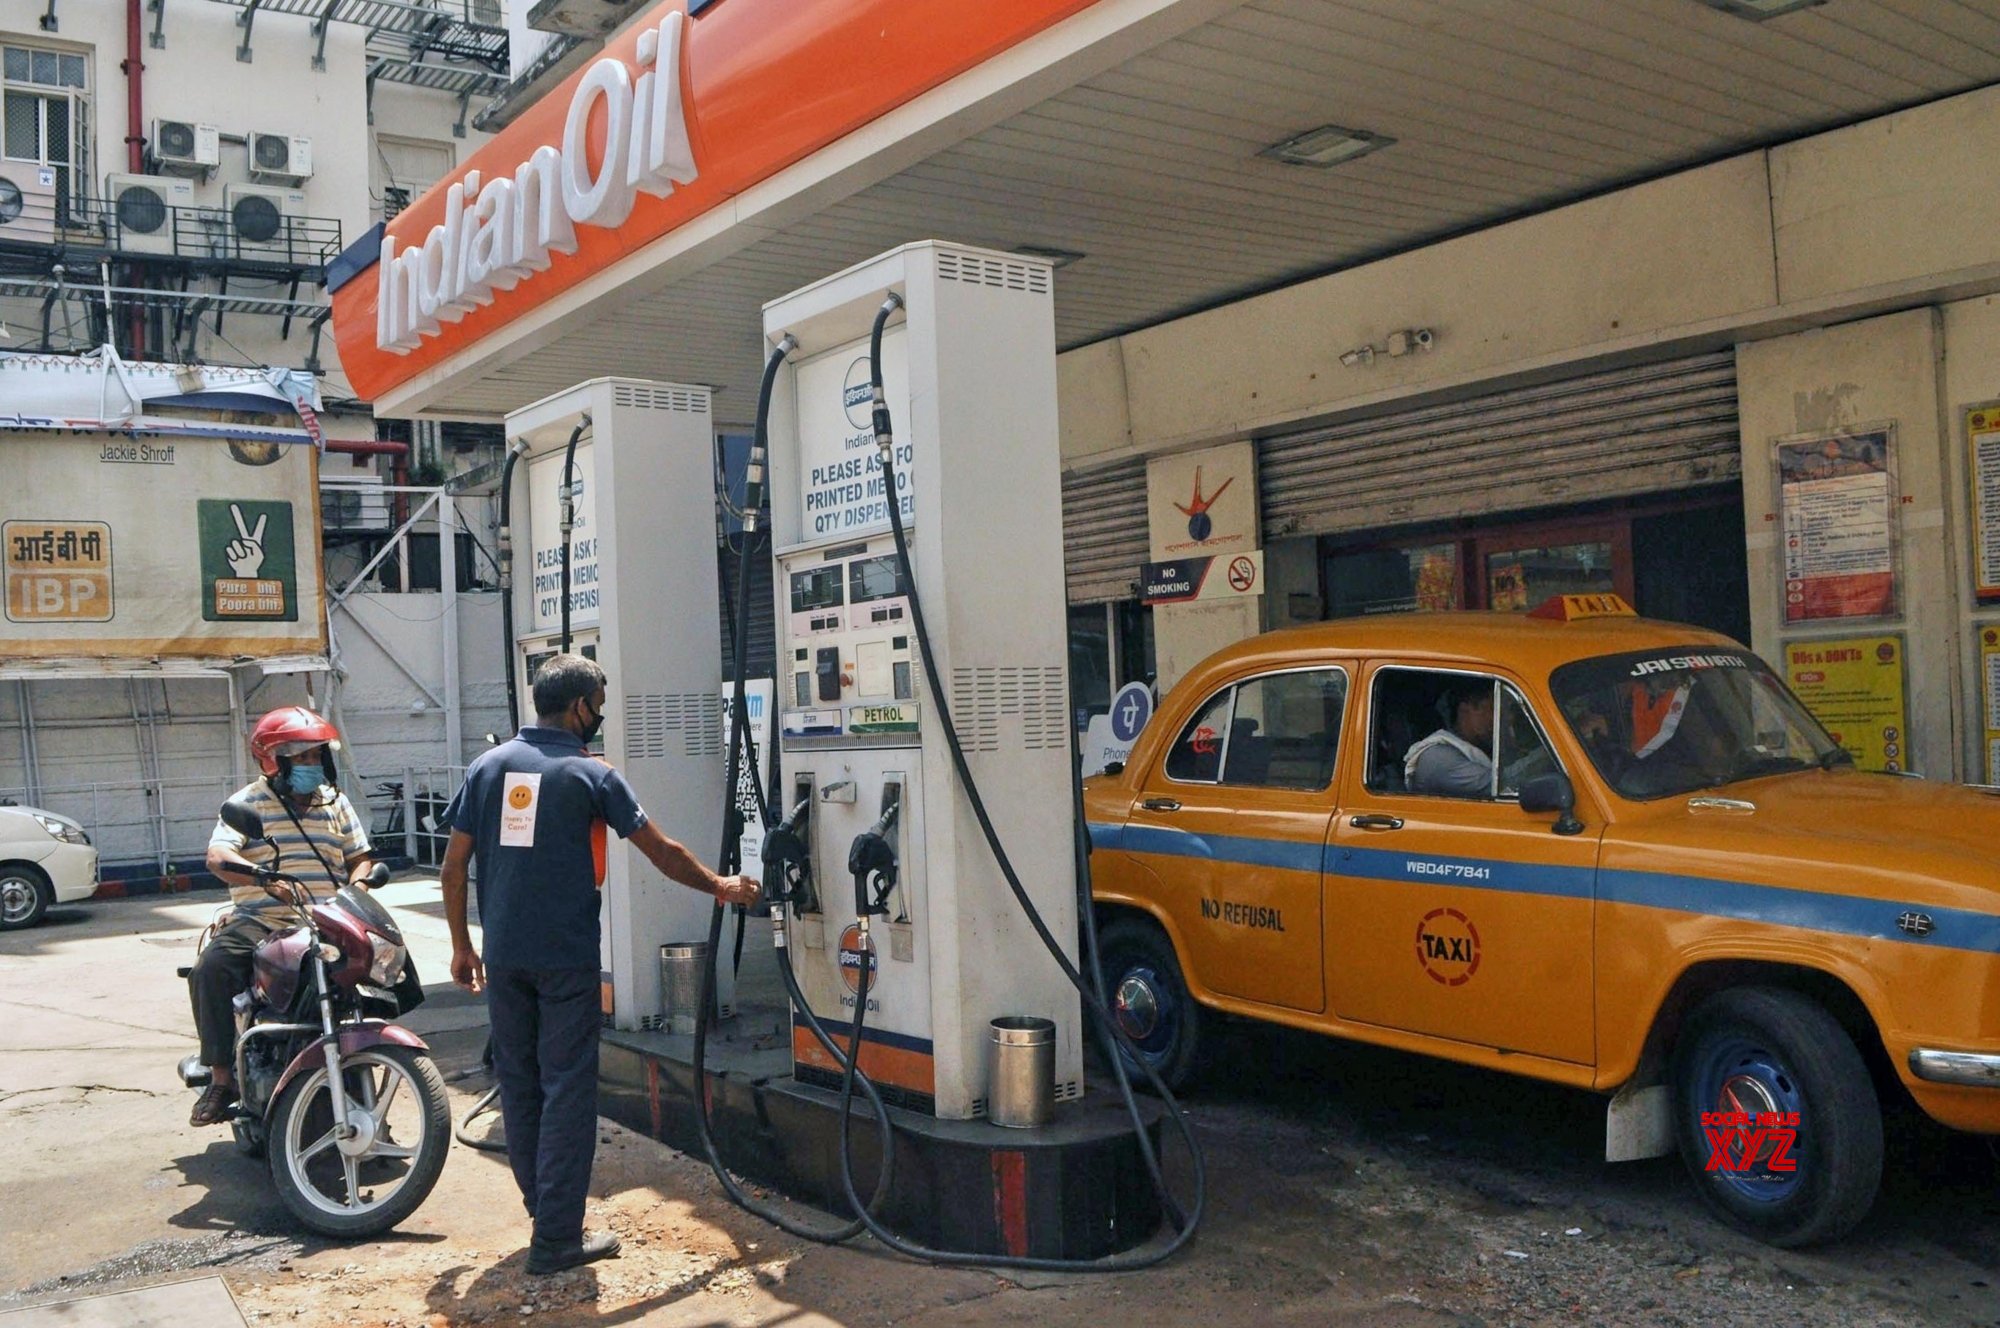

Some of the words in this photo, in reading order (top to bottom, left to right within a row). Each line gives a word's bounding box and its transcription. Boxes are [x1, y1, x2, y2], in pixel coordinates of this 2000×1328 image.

[377, 10, 698, 356] IndianOil
[845, 433, 875, 451] Indian
[100, 444, 137, 462] Jackie
[140, 445, 174, 463] Shroff
[812, 458, 862, 487] PLEASE
[865, 454, 884, 474] AS
[896, 445, 913, 466] FO
[807, 483, 862, 512] PRINTED
[867, 472, 906, 498] MEO
[815, 512, 841, 534] QTY
[537, 547, 563, 570] PLEAS
[573, 539, 592, 562] ASK
[1162, 568, 1176, 578] NO
[22, 578, 97, 614] IBP
[220, 581, 248, 594] Pure
[1147, 582, 1190, 595] SMOKING
[220, 598, 256, 611] Poora
[541, 596, 558, 617] QTY
[1631, 659, 1672, 676] JAI
[864, 707, 903, 723] PETROL
[1406, 861, 1490, 879] WB04F7841
[1201, 897, 1220, 920] NO
[1223, 901, 1286, 932] REFUSAL
[1422, 934, 1472, 963] TAXI
